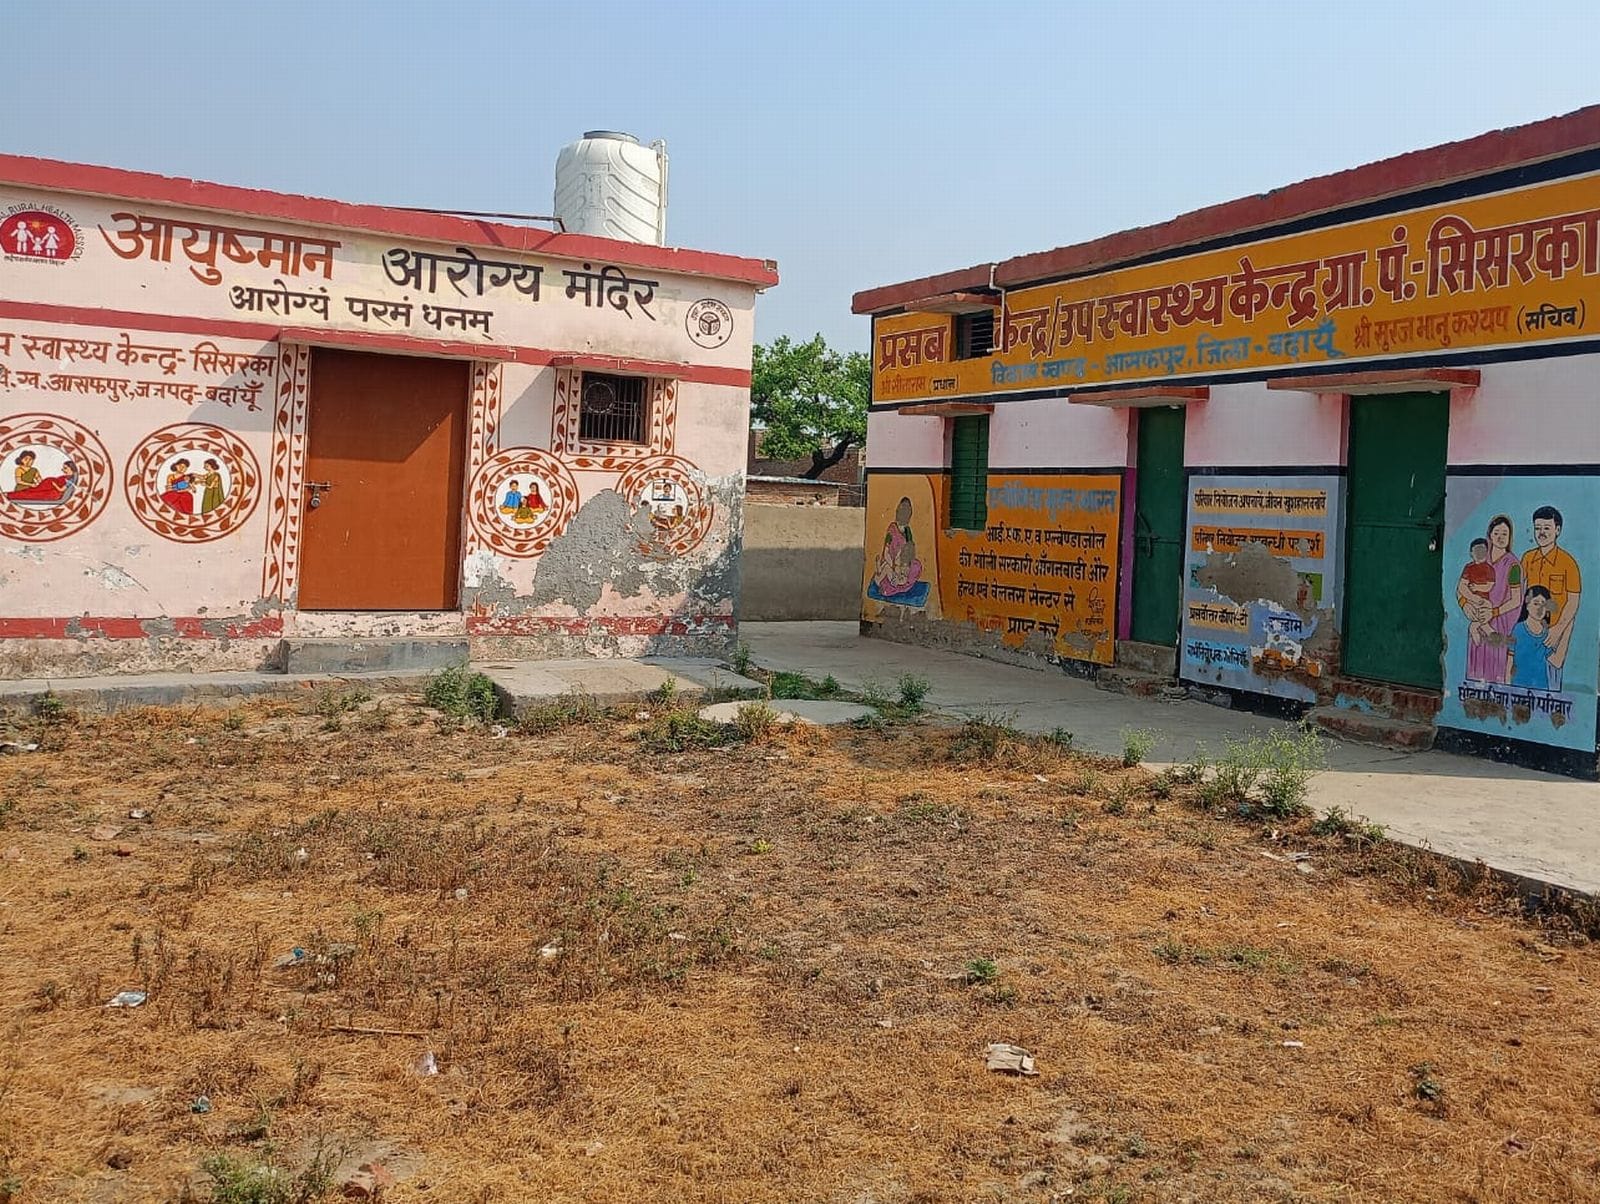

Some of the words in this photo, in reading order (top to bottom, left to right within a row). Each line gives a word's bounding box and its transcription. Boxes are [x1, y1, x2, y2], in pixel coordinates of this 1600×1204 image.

[8, 202, 40, 215] RURAL
[41, 203, 75, 226] HEALTH
[71, 223, 85, 262] MISSION
[97, 212, 342, 286] आयुष्मान
[382, 247, 544, 302] आरोग्य
[562, 262, 659, 321] मंदिर
[1229, 255, 1322, 328] केन्द्र
[229, 278, 330, 321] आरोग्यं
[344, 296, 413, 328] परमं
[422, 304, 495, 341] धनम्
[1516, 298, 1586, 335] (सचिव)
[21, 333, 113, 364] स्वास्थ्य
[189, 341, 277, 377] सिसरका
[974, 548, 997, 571] गोली
[1088, 556, 1110, 583] और
[1063, 586, 1076, 613] से
